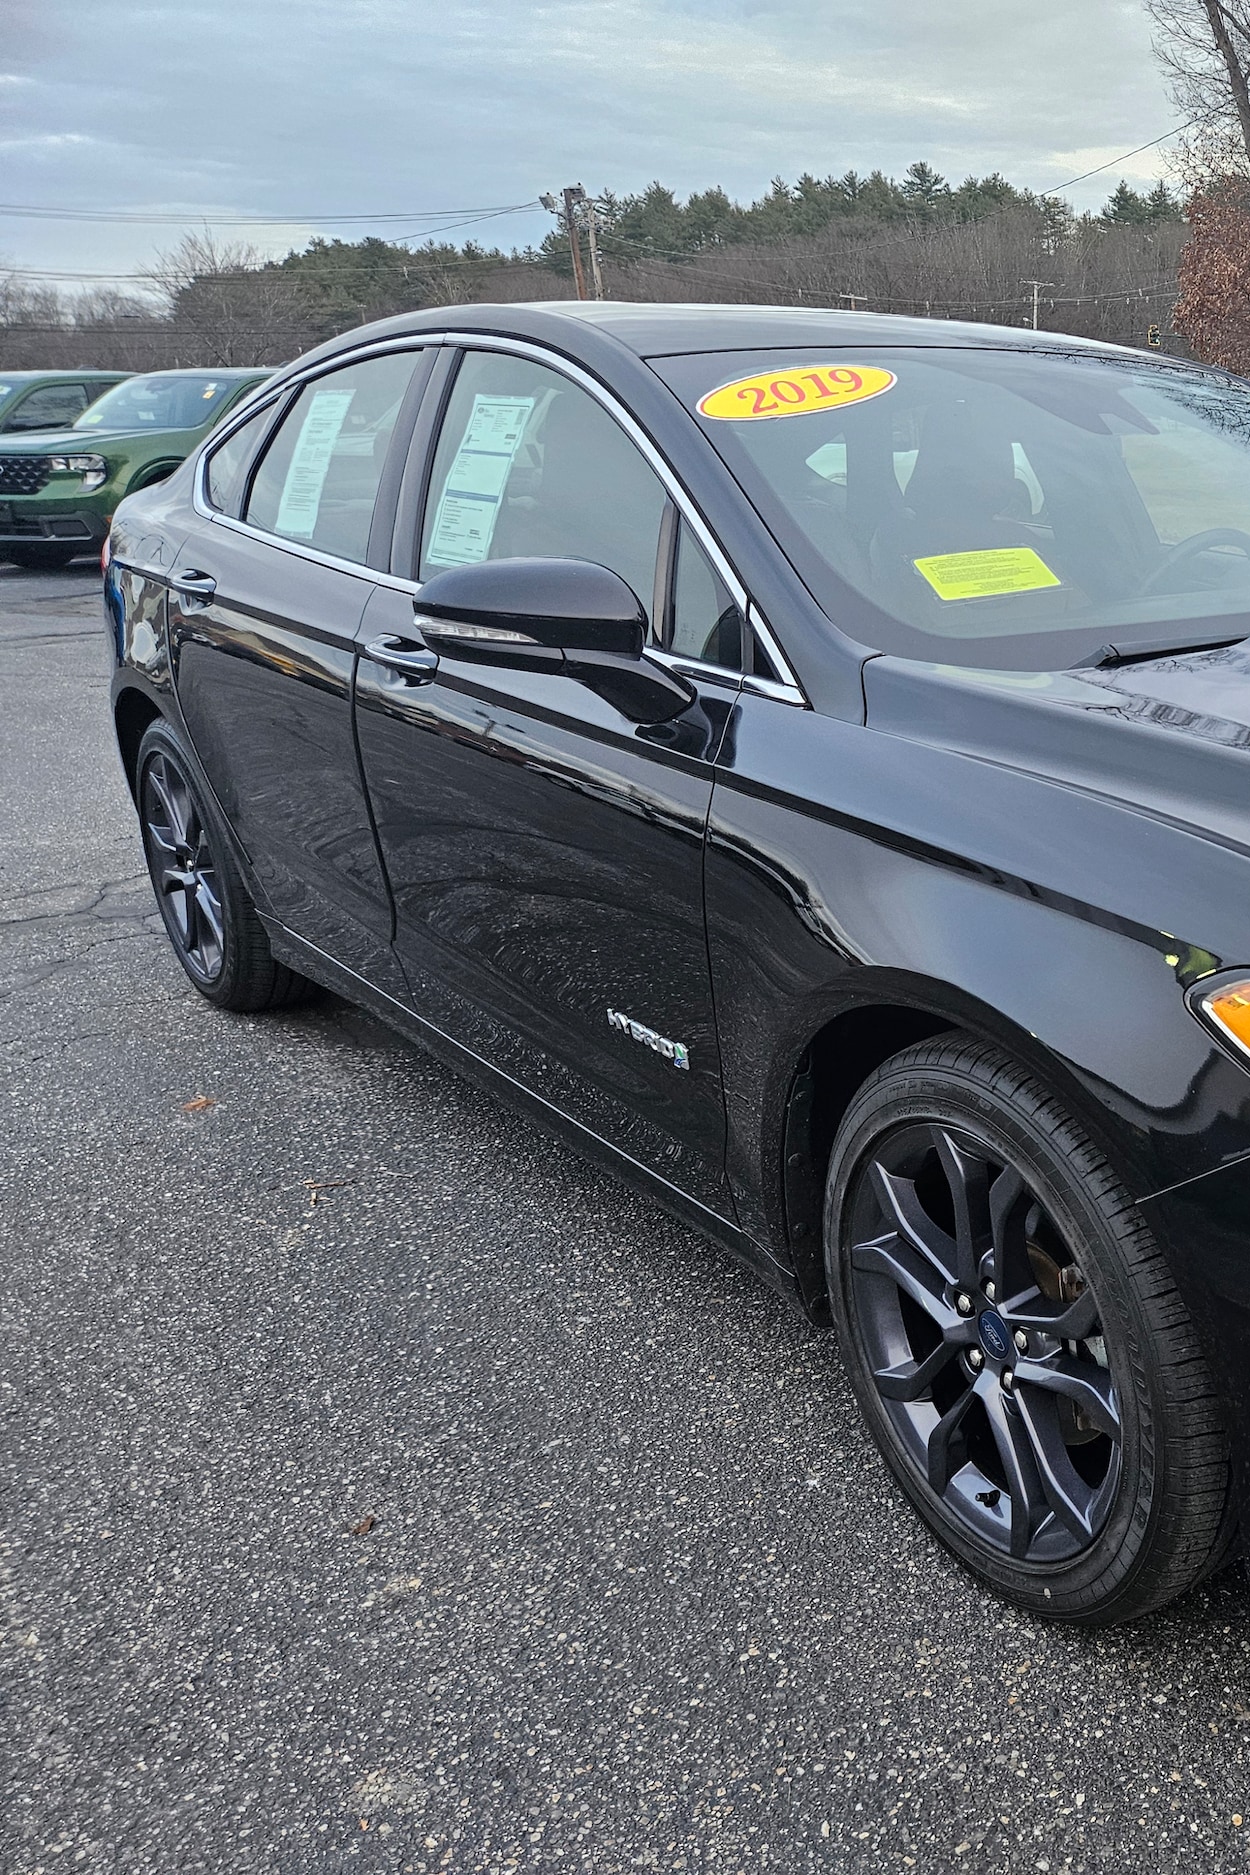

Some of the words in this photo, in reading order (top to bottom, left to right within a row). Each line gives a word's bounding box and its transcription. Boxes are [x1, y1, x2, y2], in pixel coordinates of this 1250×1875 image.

[738, 368, 862, 414] 2019
[606, 1007, 675, 1058] HYBRID
[984, 1323, 1001, 1348] Ford
